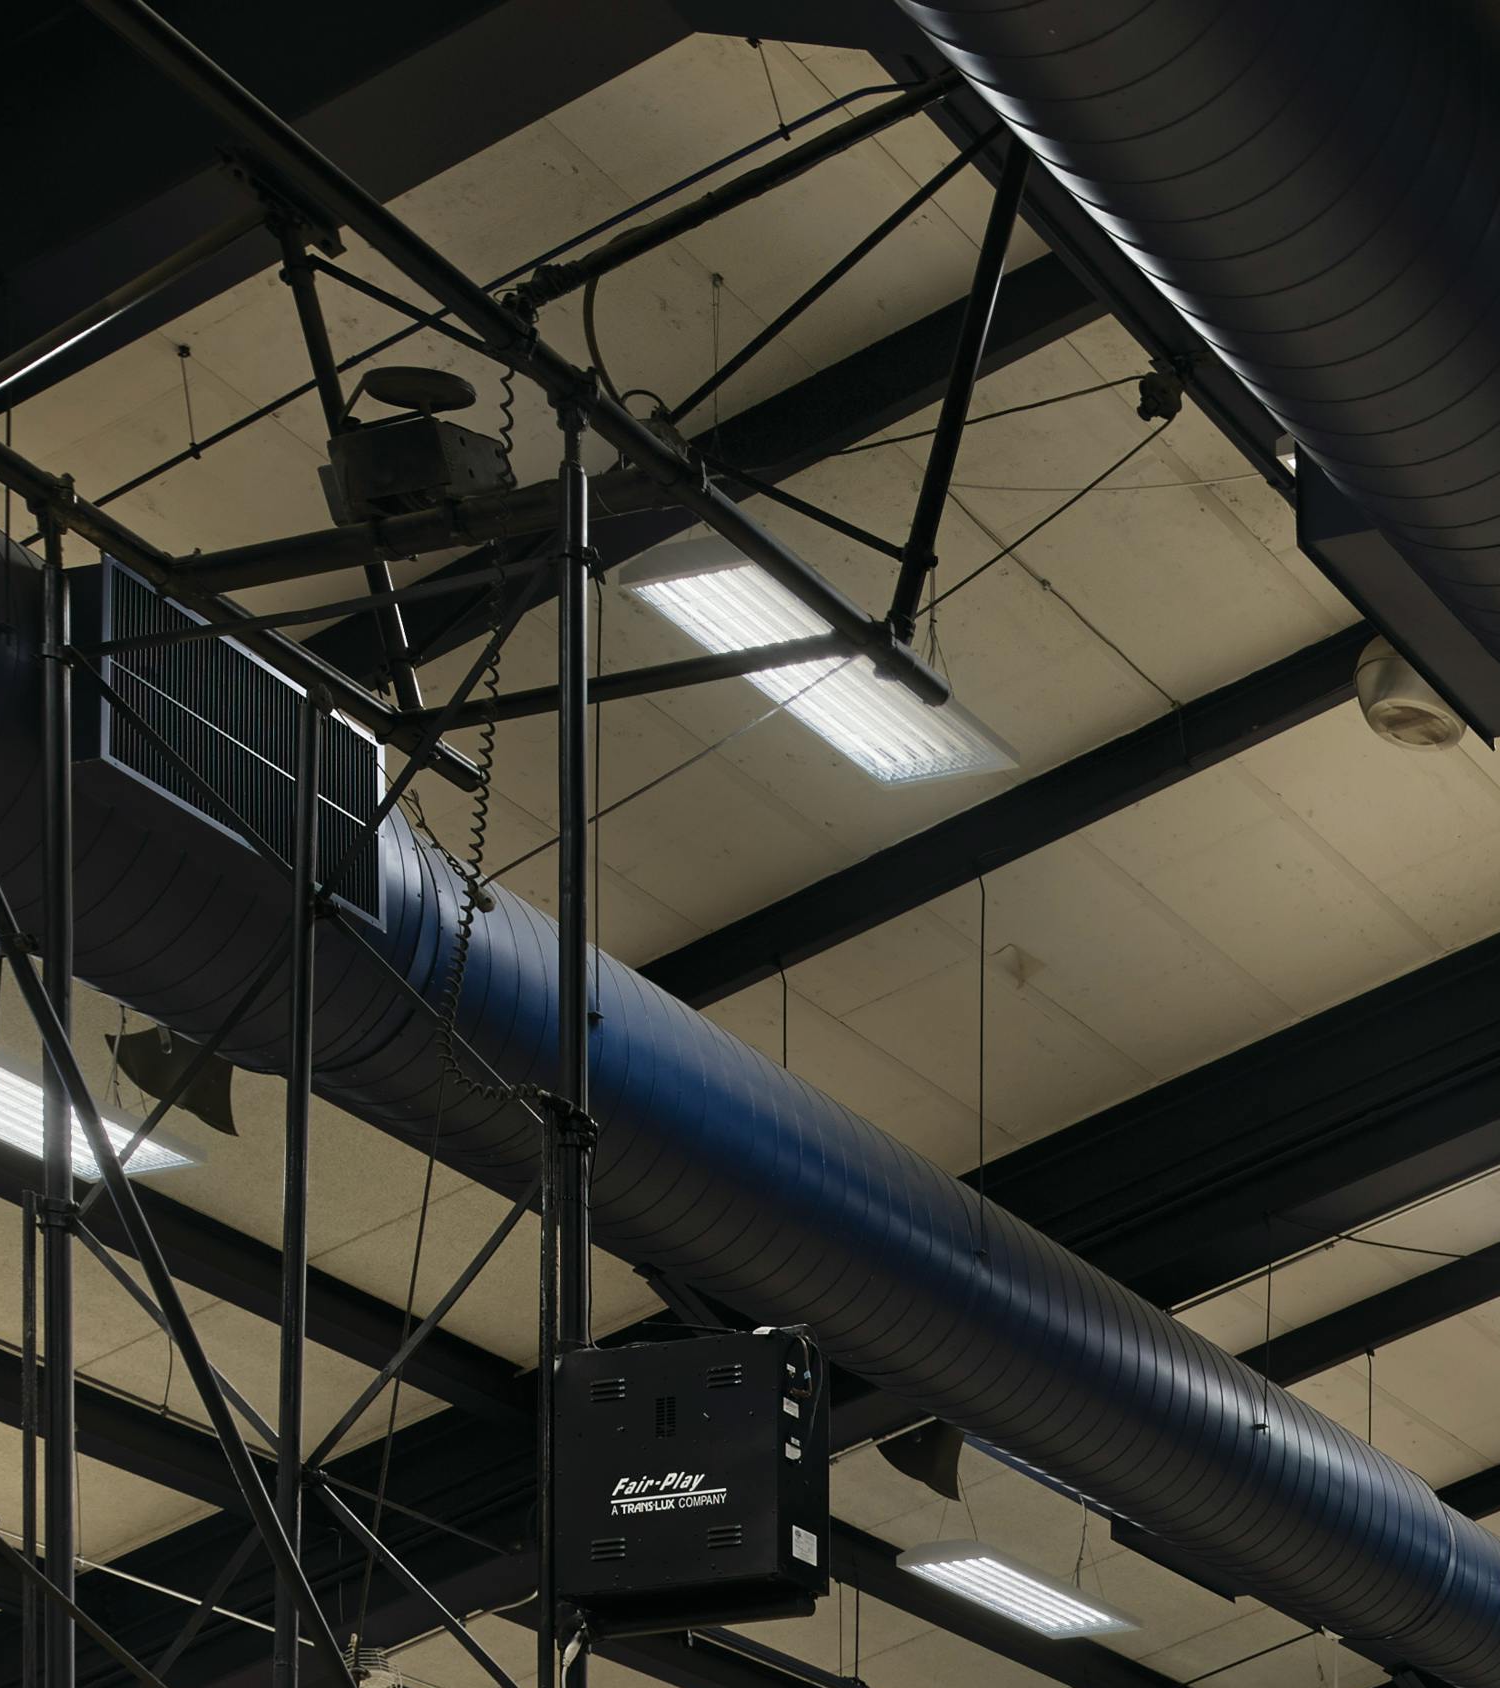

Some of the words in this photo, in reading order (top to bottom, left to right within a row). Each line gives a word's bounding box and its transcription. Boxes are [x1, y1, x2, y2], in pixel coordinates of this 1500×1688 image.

[612, 1471, 705, 1496] Fair-Play
[611, 1505, 618, 1515] A
[678, 1493, 727, 1508] COMPANY
